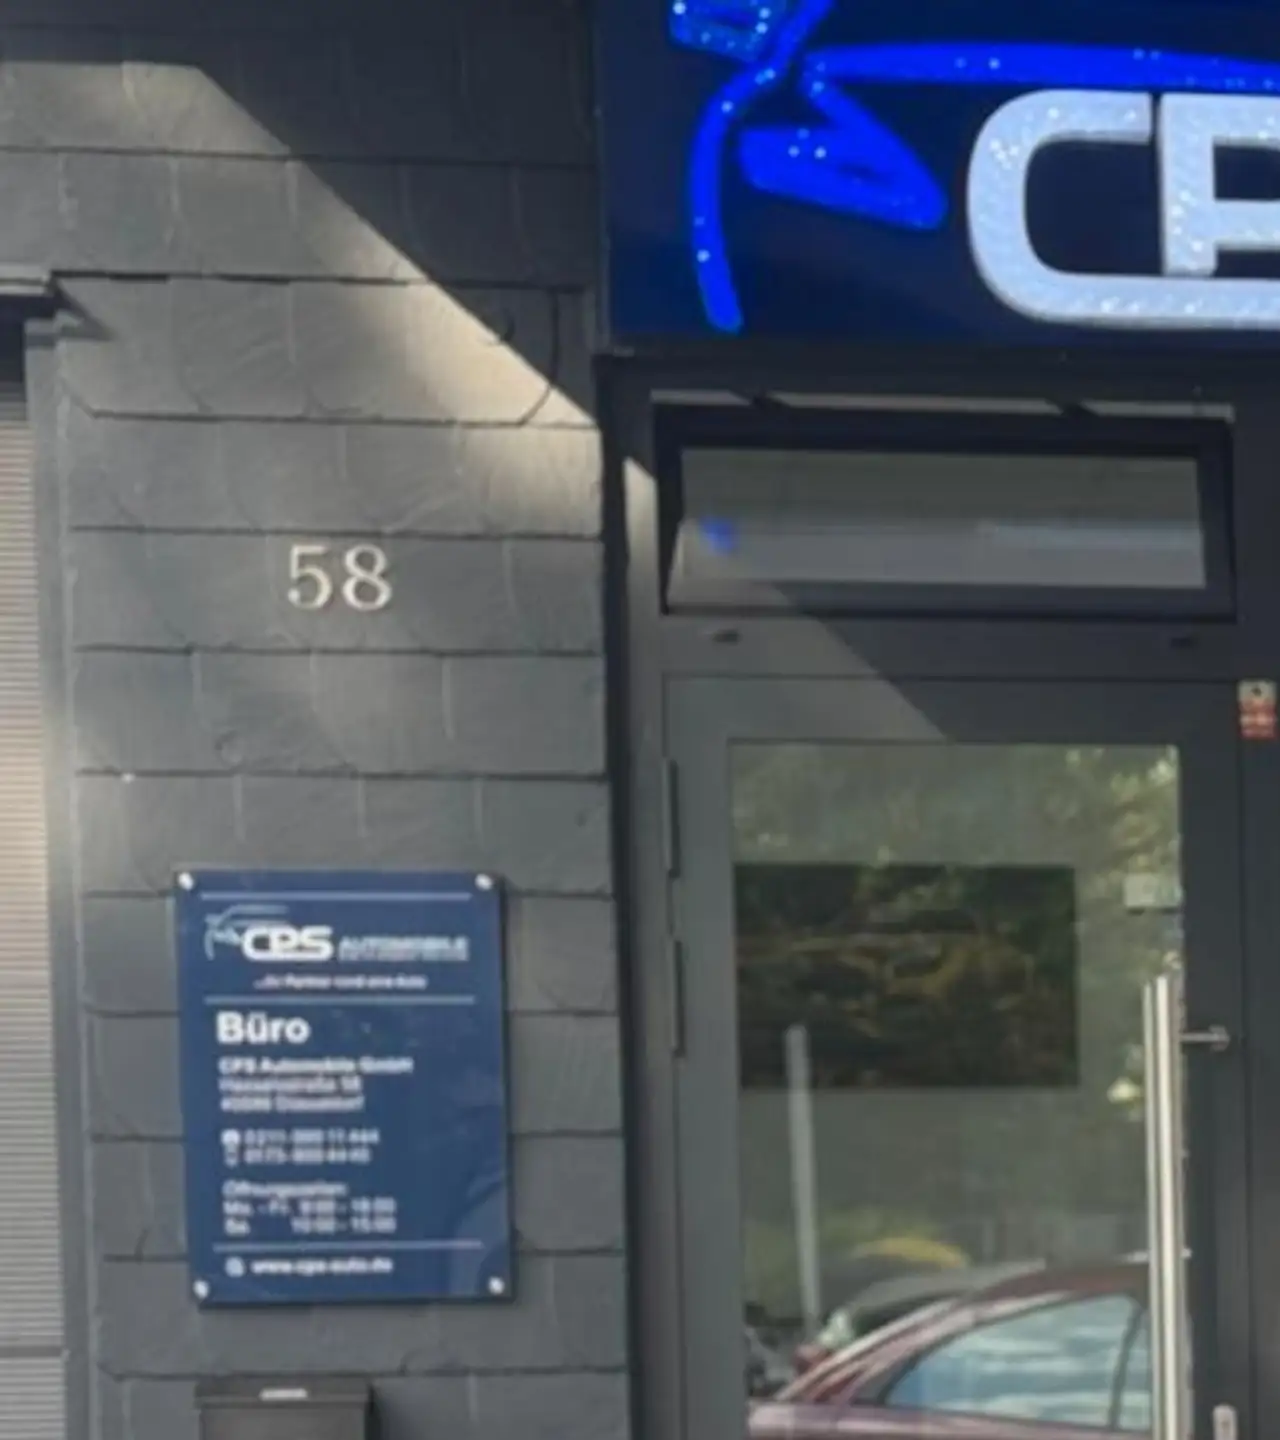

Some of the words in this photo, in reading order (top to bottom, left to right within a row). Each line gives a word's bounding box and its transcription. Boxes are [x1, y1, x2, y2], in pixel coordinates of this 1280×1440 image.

[288, 543, 393, 612] 58
[242, 925, 334, 962] CPS
[216, 1011, 311, 1044] Büro
